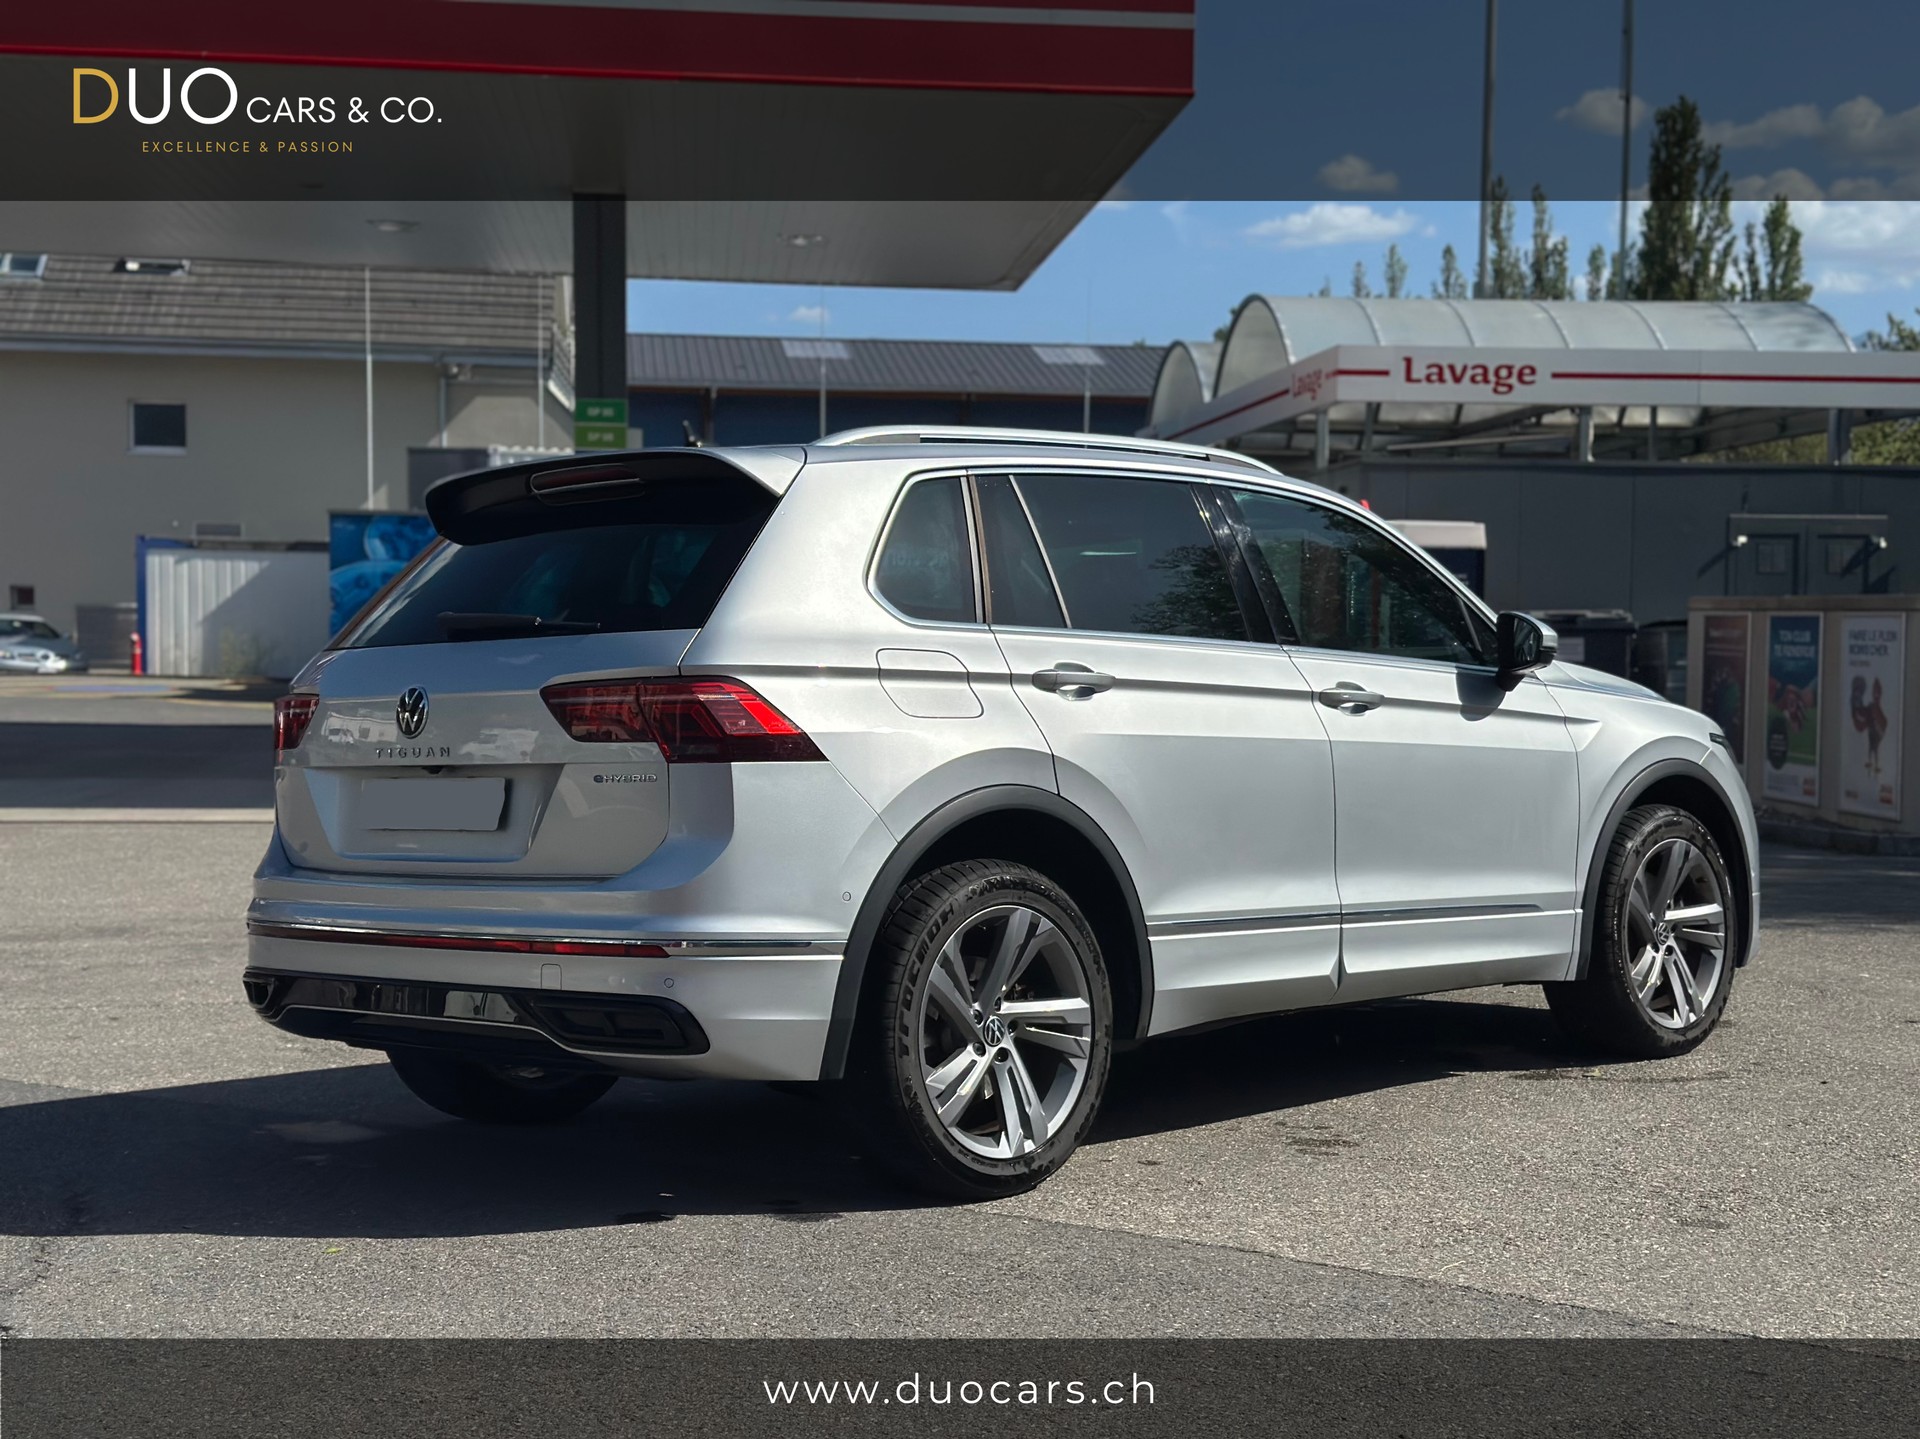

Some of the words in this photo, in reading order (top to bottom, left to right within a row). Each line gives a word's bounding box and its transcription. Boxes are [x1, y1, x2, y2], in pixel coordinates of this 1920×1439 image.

[1291, 368, 1323, 400] Lavage
[1402, 355, 1538, 396] Lavage
[375, 746, 452, 759] TIGUAN
